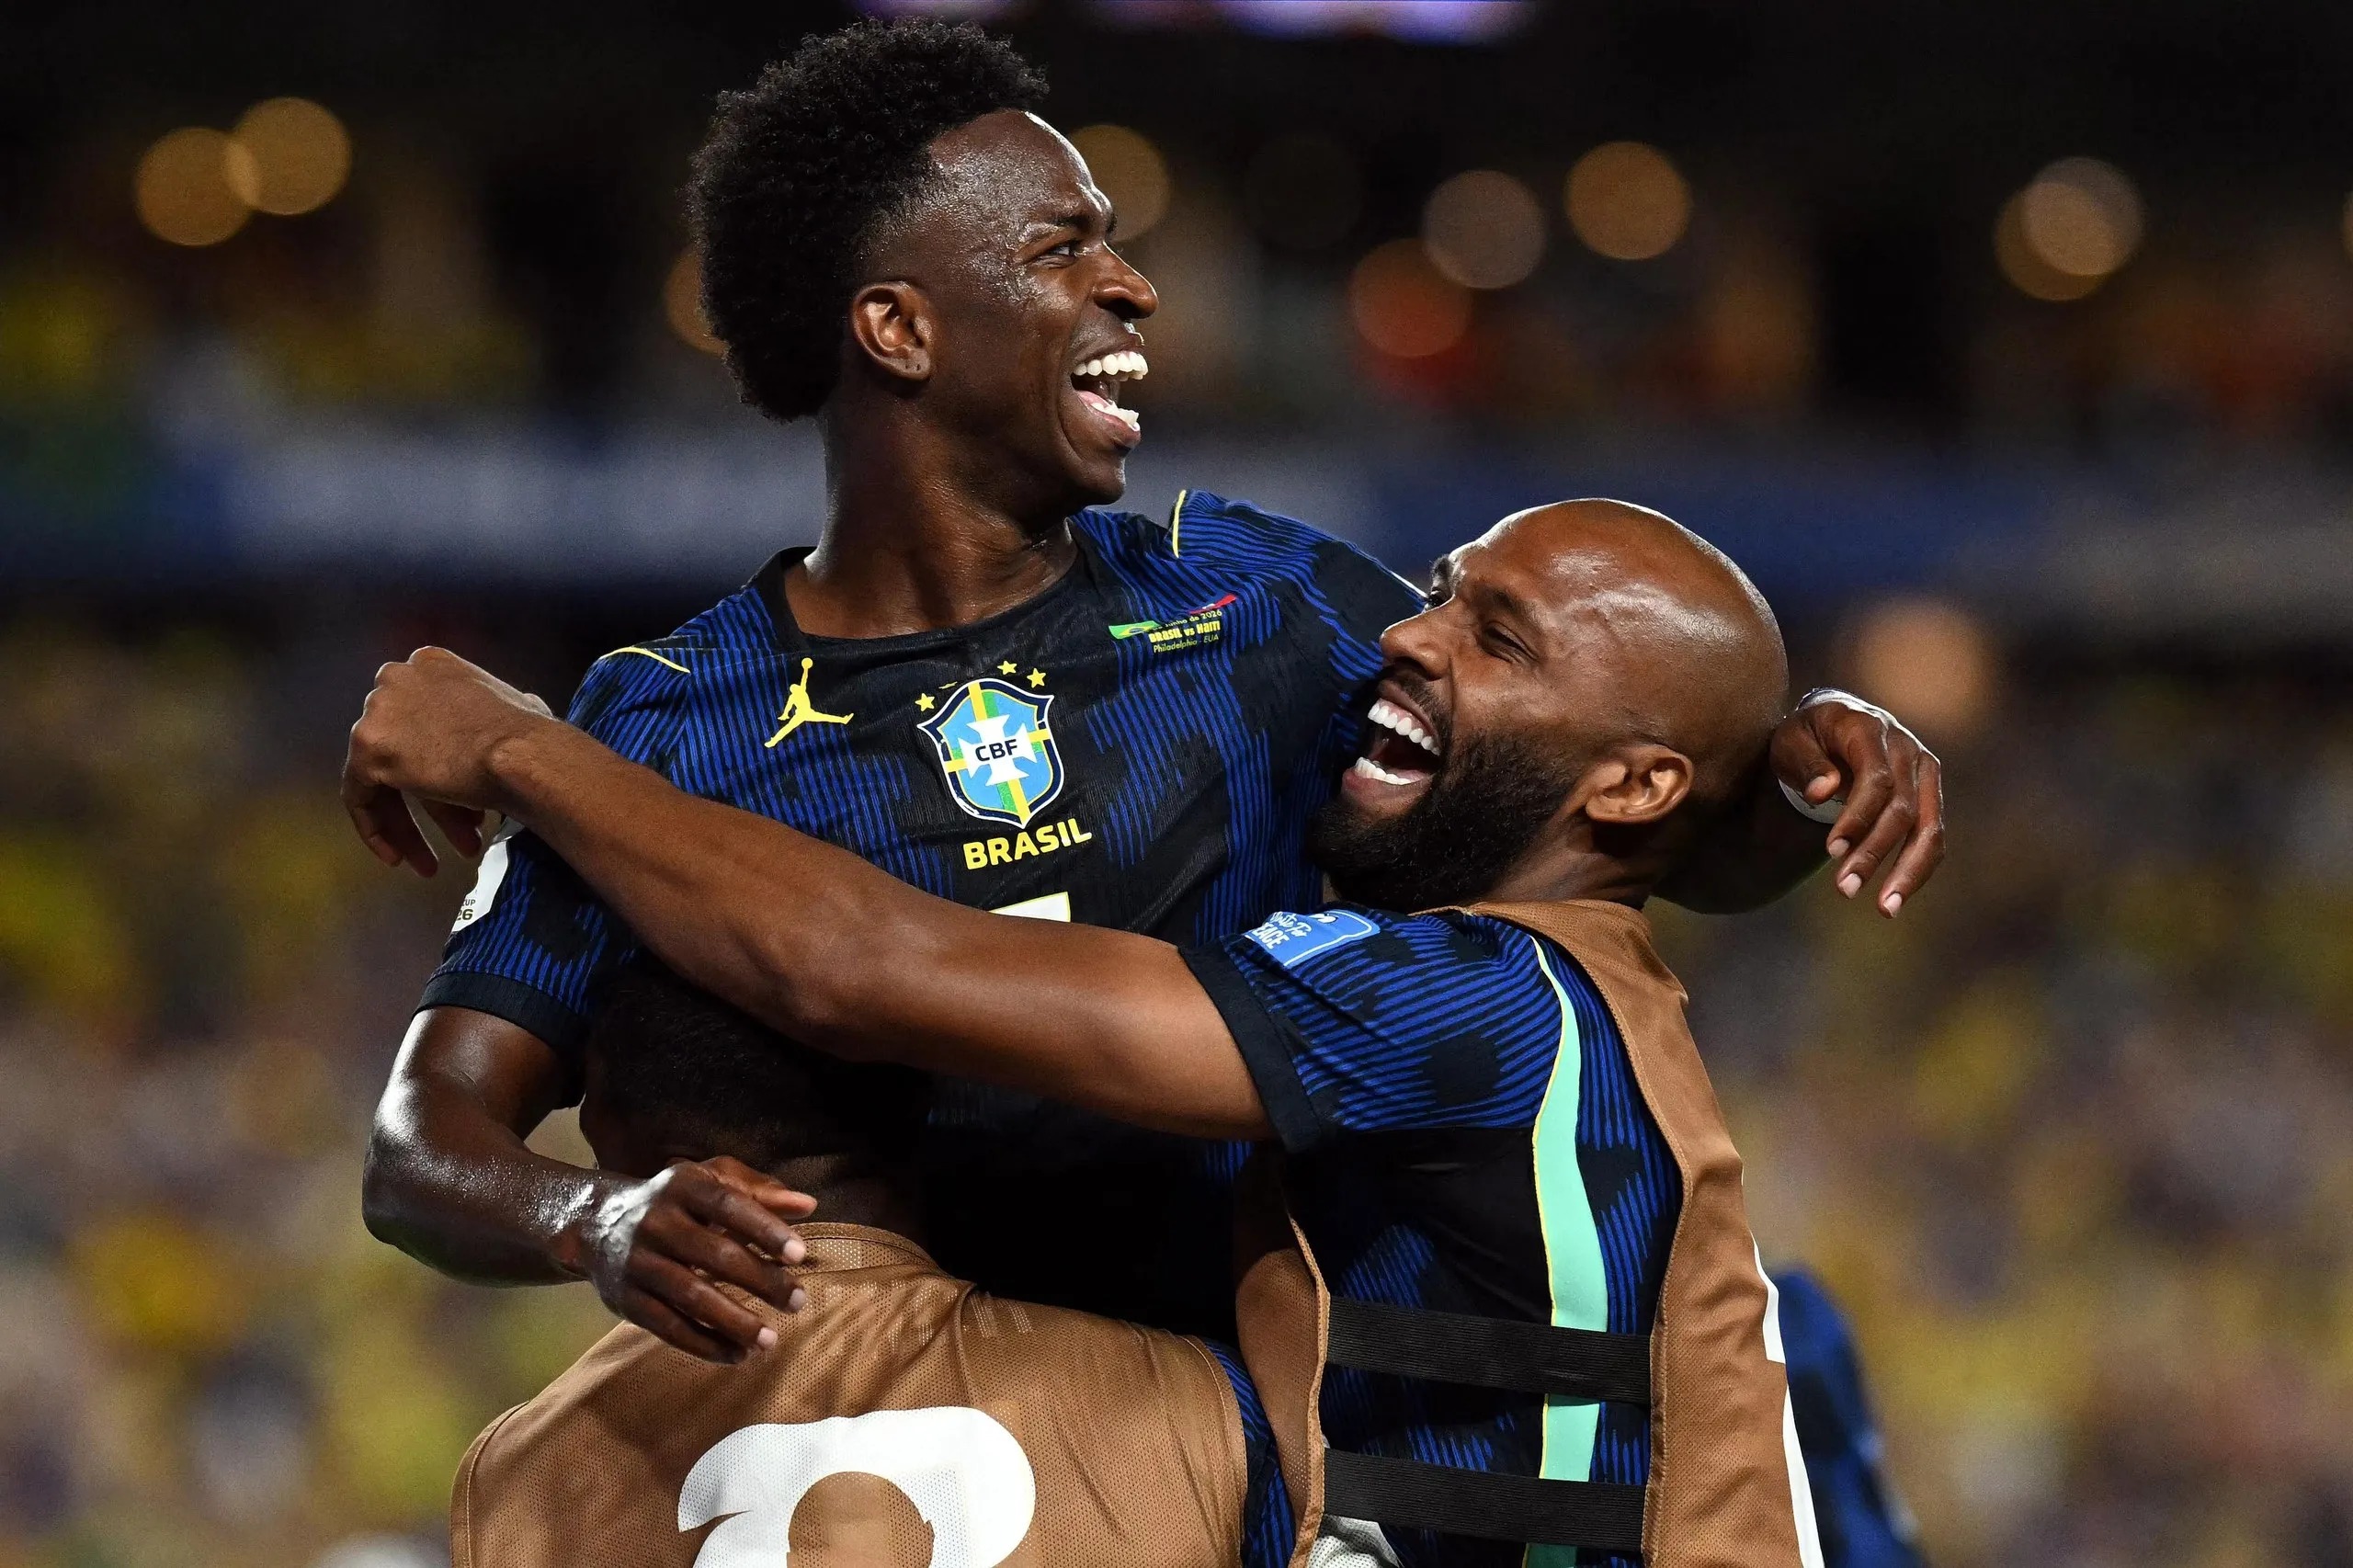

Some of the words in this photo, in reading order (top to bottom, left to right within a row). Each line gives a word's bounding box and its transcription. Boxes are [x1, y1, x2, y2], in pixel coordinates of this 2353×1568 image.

[1200, 609, 1222, 619] 2026
[1154, 639, 1198, 653] Philadelphia
[1203, 633, 1220, 643] EUA
[1184, 628, 1195, 636] vs
[974, 738, 1018, 762] CBF
[963, 818, 1093, 869] BRASIL
[1251, 922, 1290, 949] EACE
